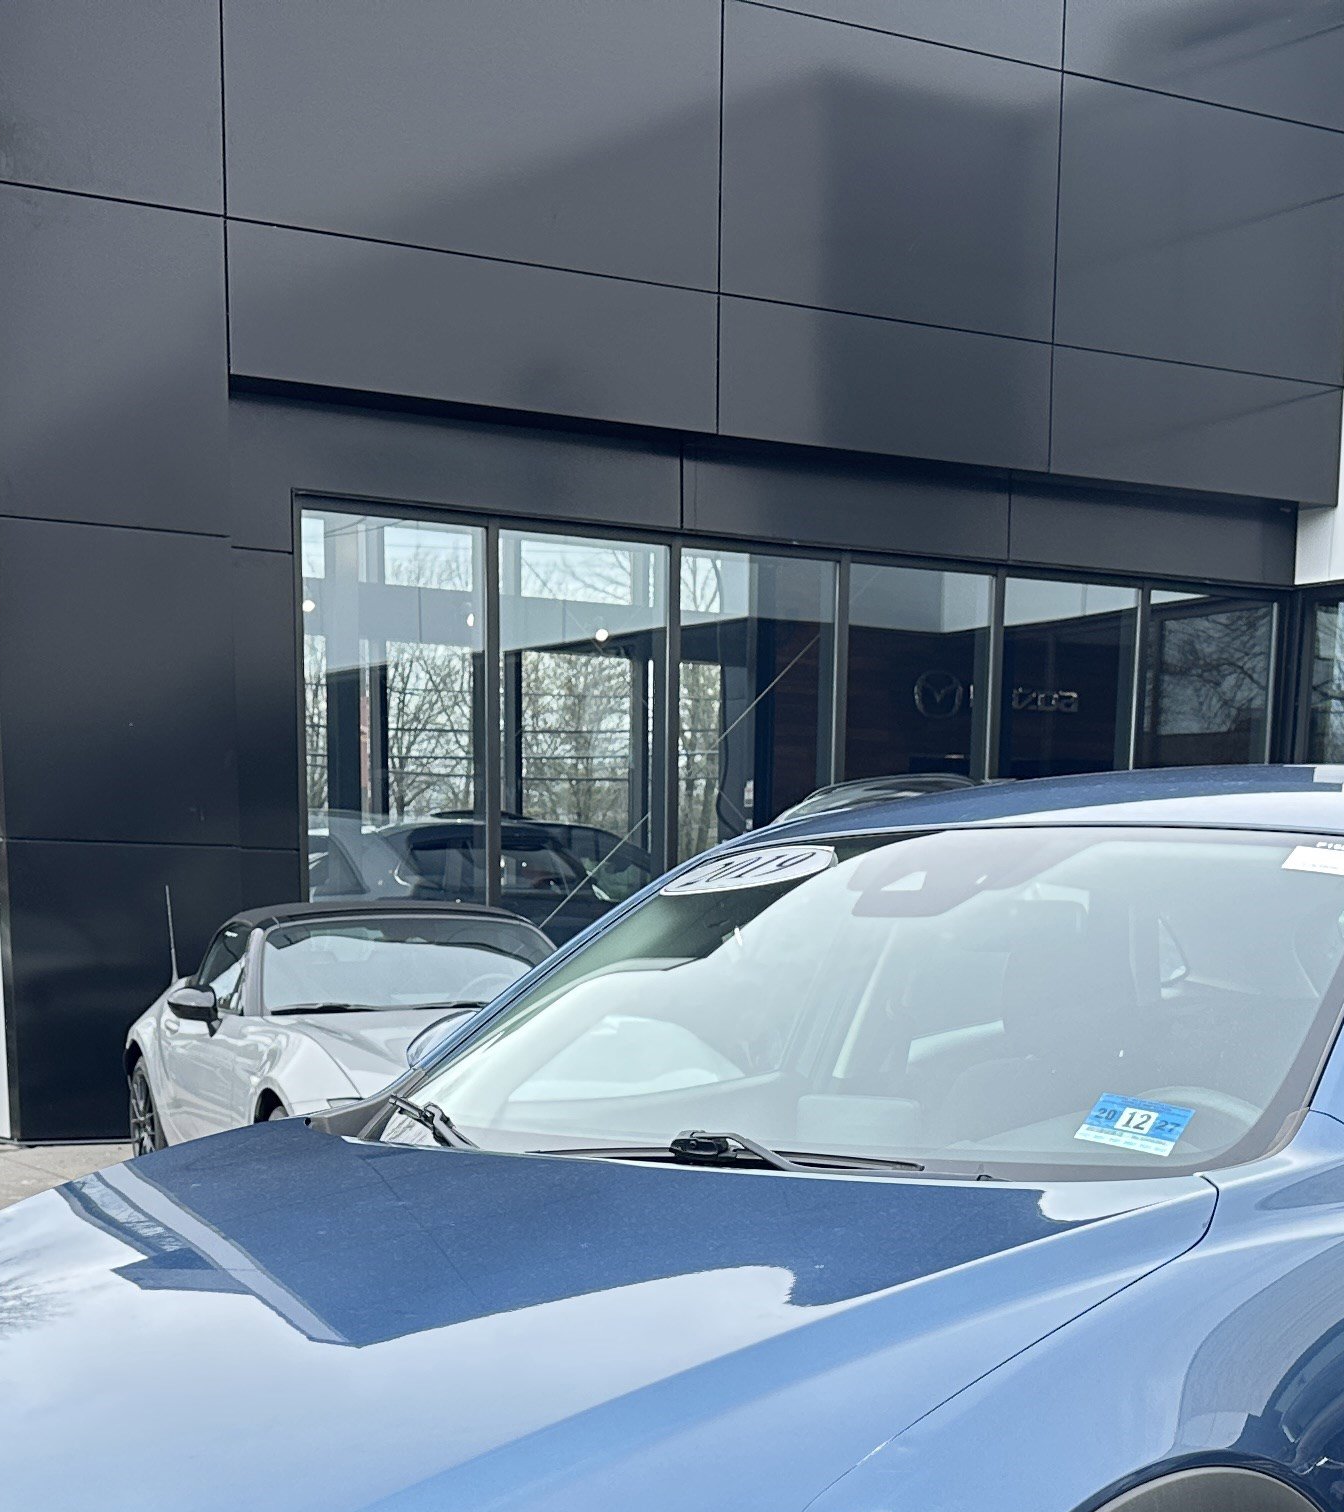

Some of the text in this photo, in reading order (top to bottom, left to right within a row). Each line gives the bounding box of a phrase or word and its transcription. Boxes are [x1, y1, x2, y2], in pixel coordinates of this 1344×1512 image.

[676, 852, 817, 888] 2019
[1094, 1107, 1181, 1133] 20 12 27
